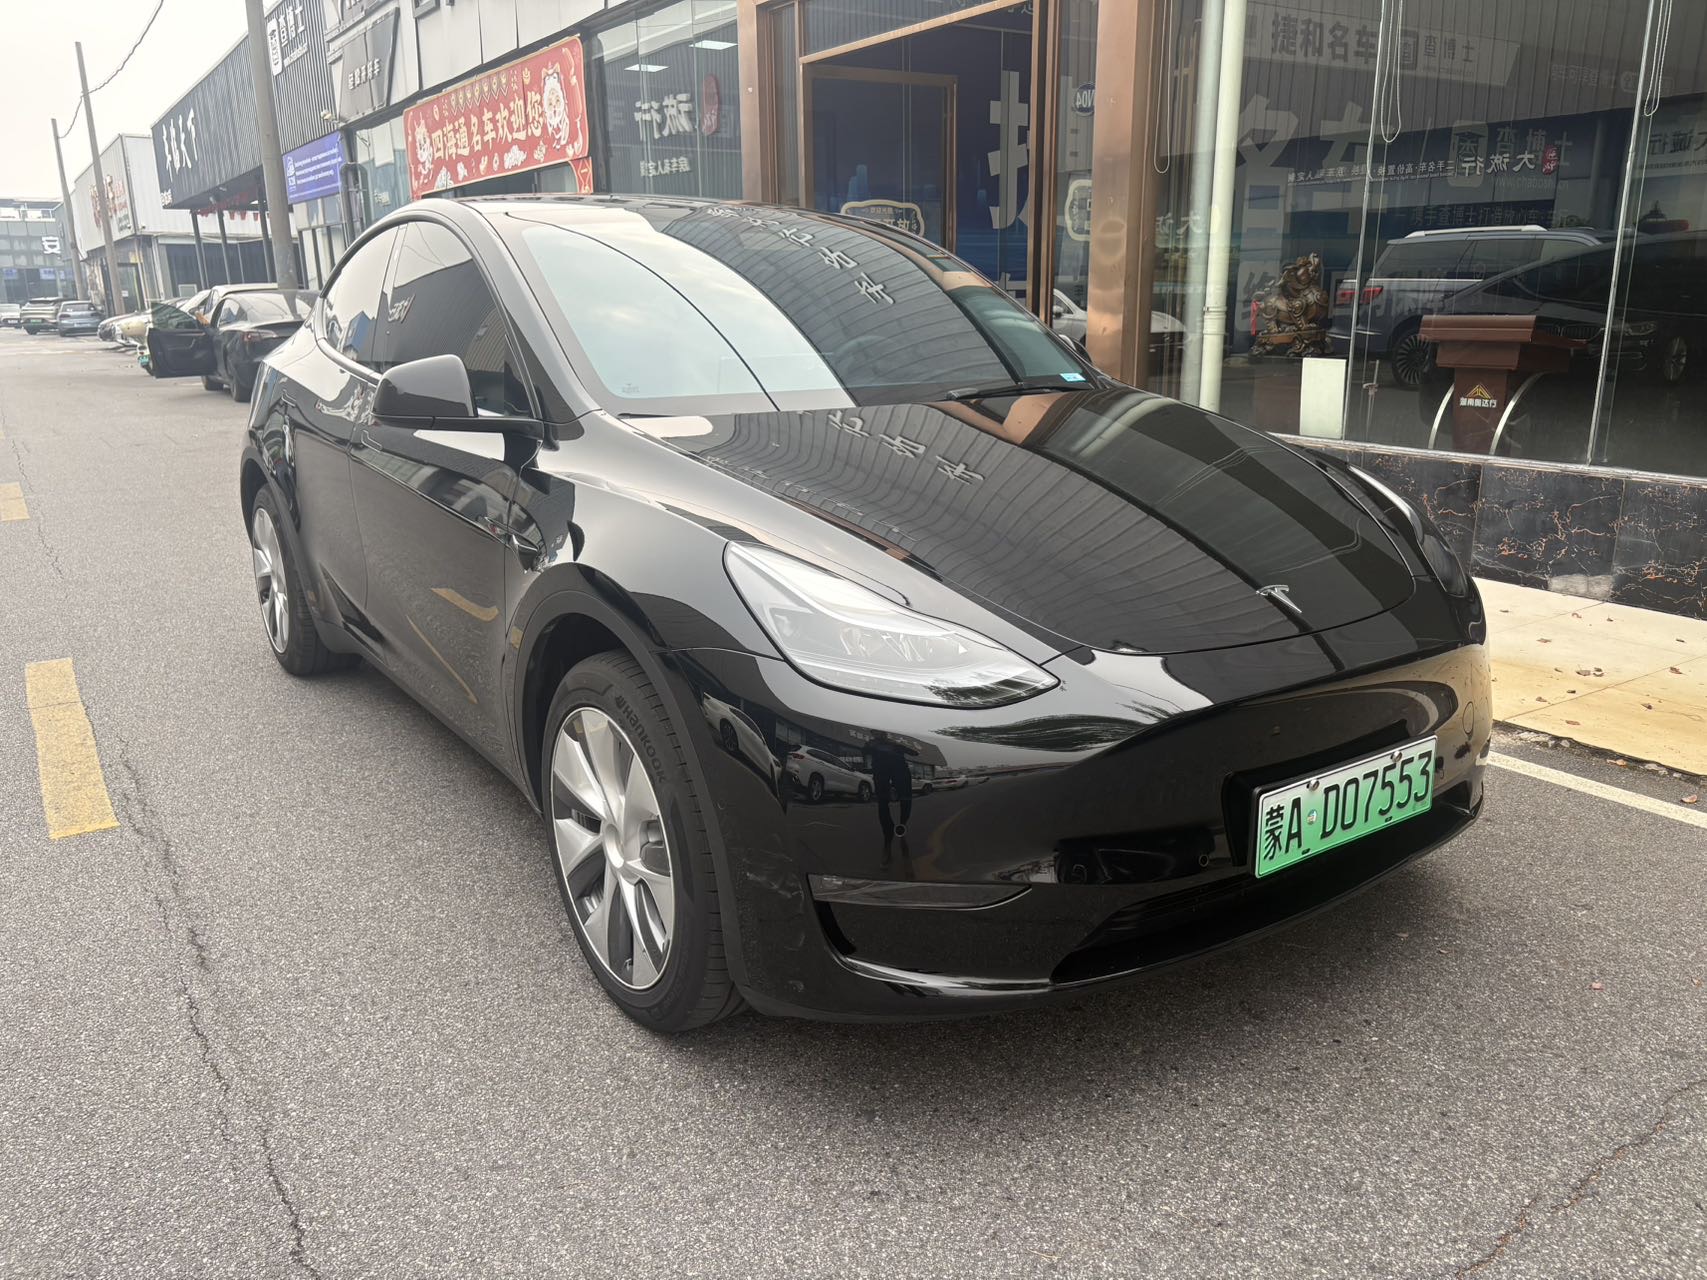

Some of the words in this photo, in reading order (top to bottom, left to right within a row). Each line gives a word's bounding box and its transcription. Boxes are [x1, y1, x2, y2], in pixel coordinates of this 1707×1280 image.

[431, 90, 545, 162] 四海通名车欢迎您
